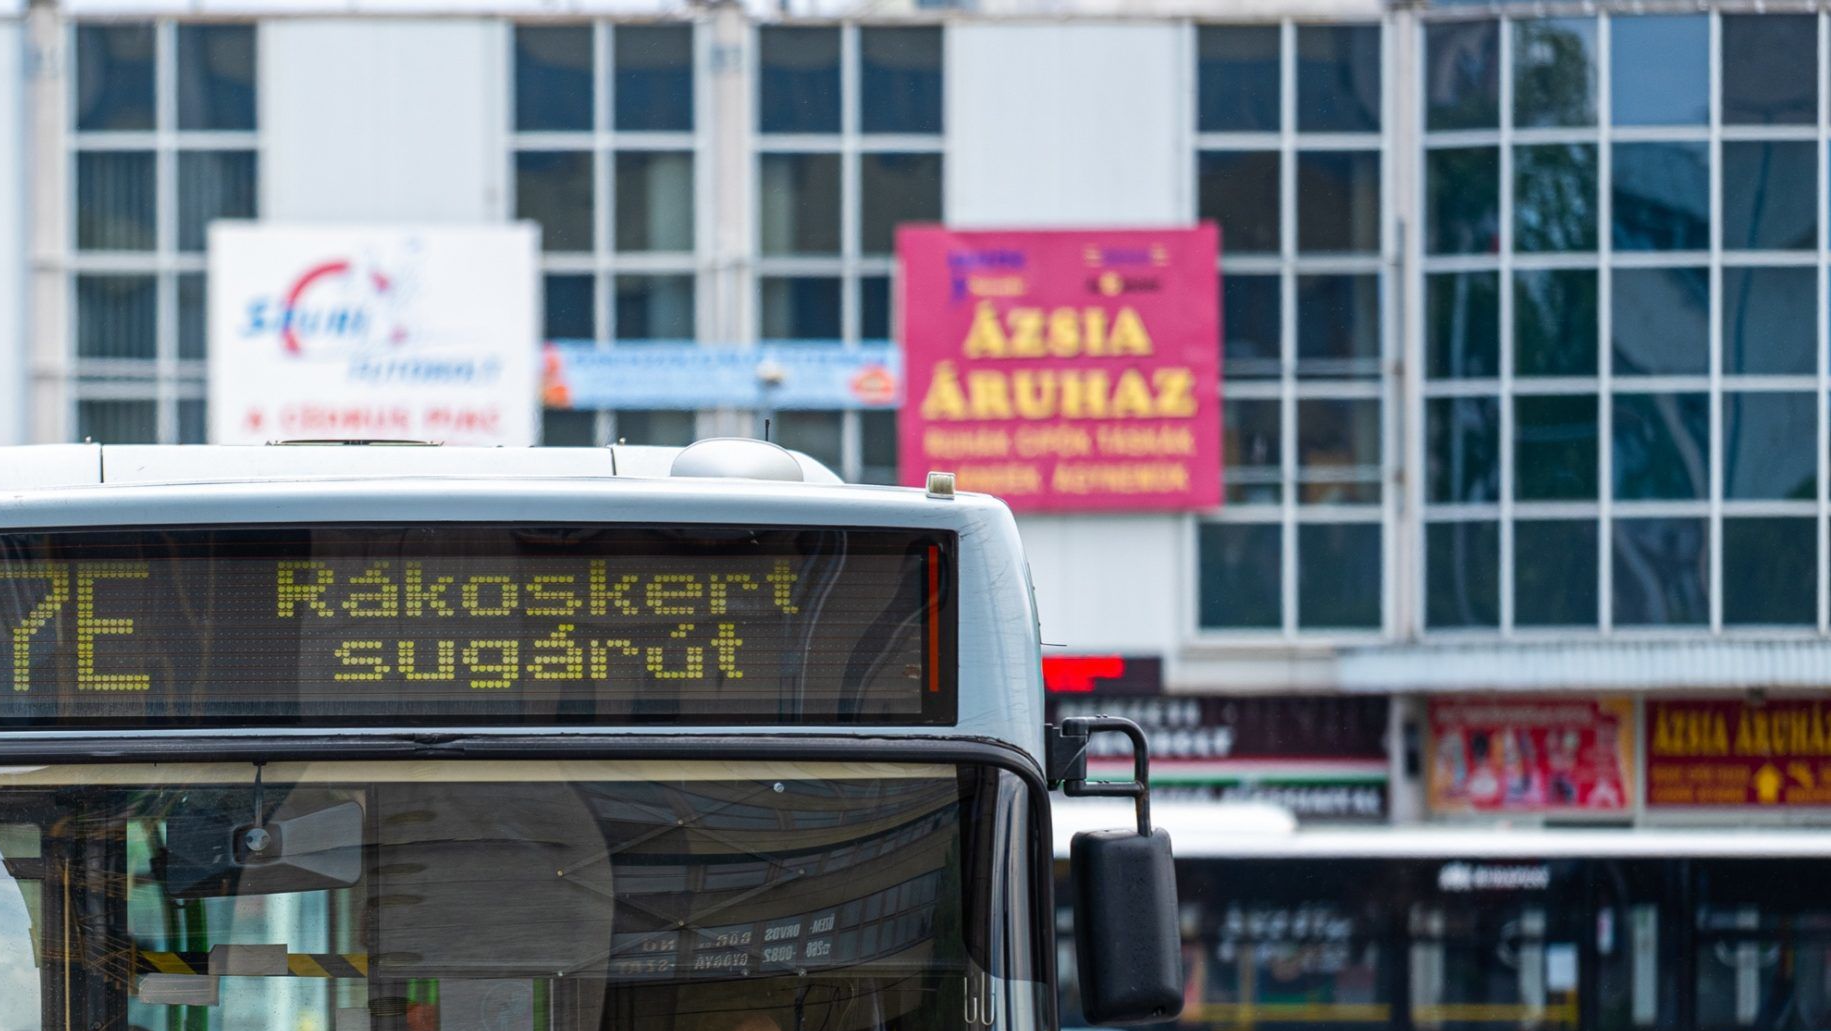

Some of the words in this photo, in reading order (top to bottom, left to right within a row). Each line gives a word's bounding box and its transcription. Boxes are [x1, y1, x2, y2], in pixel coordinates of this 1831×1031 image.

[962, 299, 1155, 359] ÁZSIA
[276, 559, 799, 616] Rákoskert
[334, 623, 743, 689] sugárút
